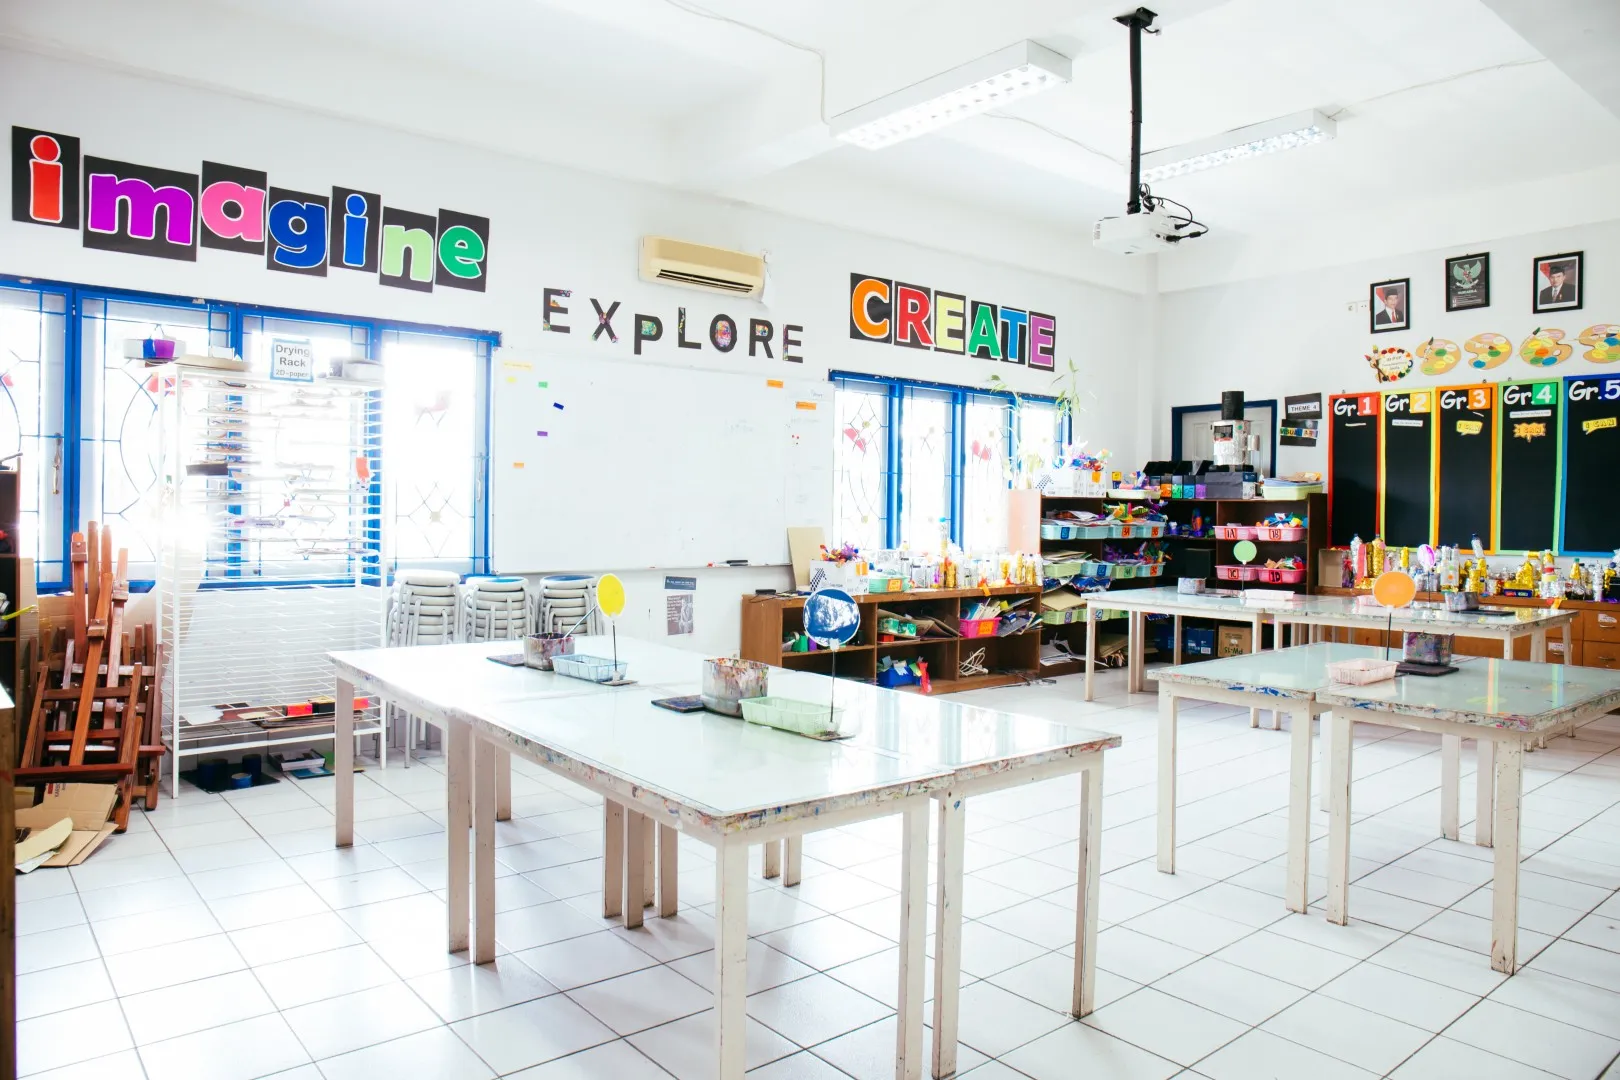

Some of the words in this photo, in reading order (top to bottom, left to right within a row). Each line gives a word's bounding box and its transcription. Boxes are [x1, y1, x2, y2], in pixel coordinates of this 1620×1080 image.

[29, 134, 486, 283] imagine
[542, 287, 804, 363] EXPLORE
[851, 278, 1055, 368] CREATE
[275, 344, 310, 357] Drying
[279, 357, 306, 368] Rack
[1593, 418, 1615, 428] CAN
[1227, 528, 1235, 538] 1A
[1270, 571, 1280, 582] 1D
